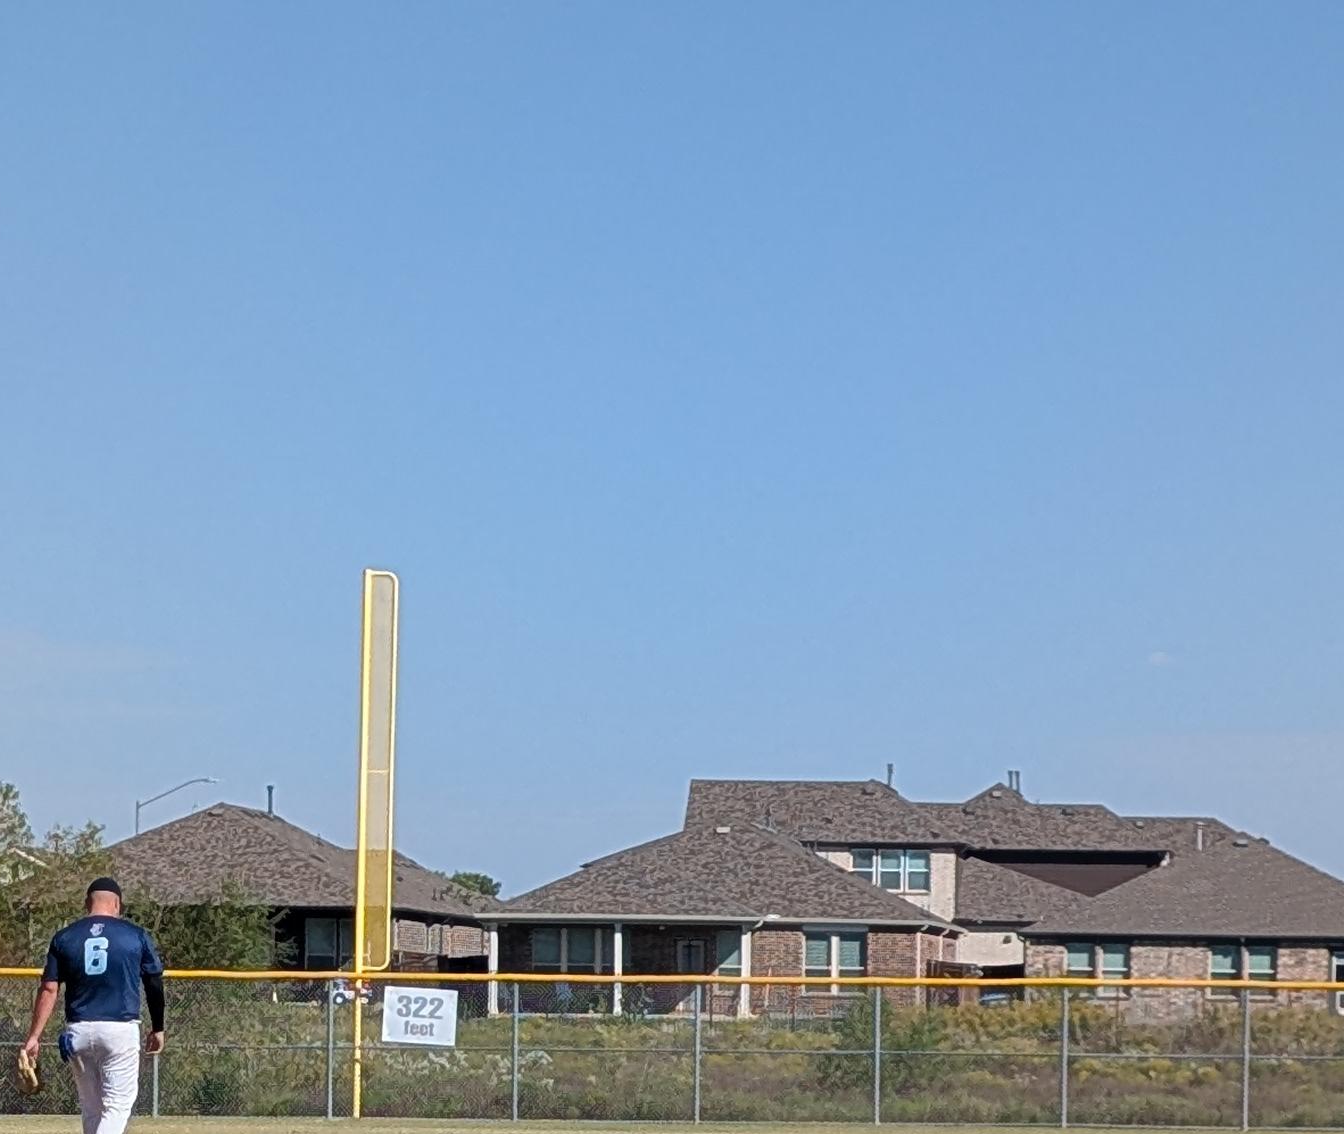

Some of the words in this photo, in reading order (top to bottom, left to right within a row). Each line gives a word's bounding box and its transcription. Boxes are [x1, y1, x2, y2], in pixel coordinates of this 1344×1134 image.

[84, 937, 109, 975] 6
[397, 995, 444, 1019] 322
[404, 1020, 435, 1037] feet
